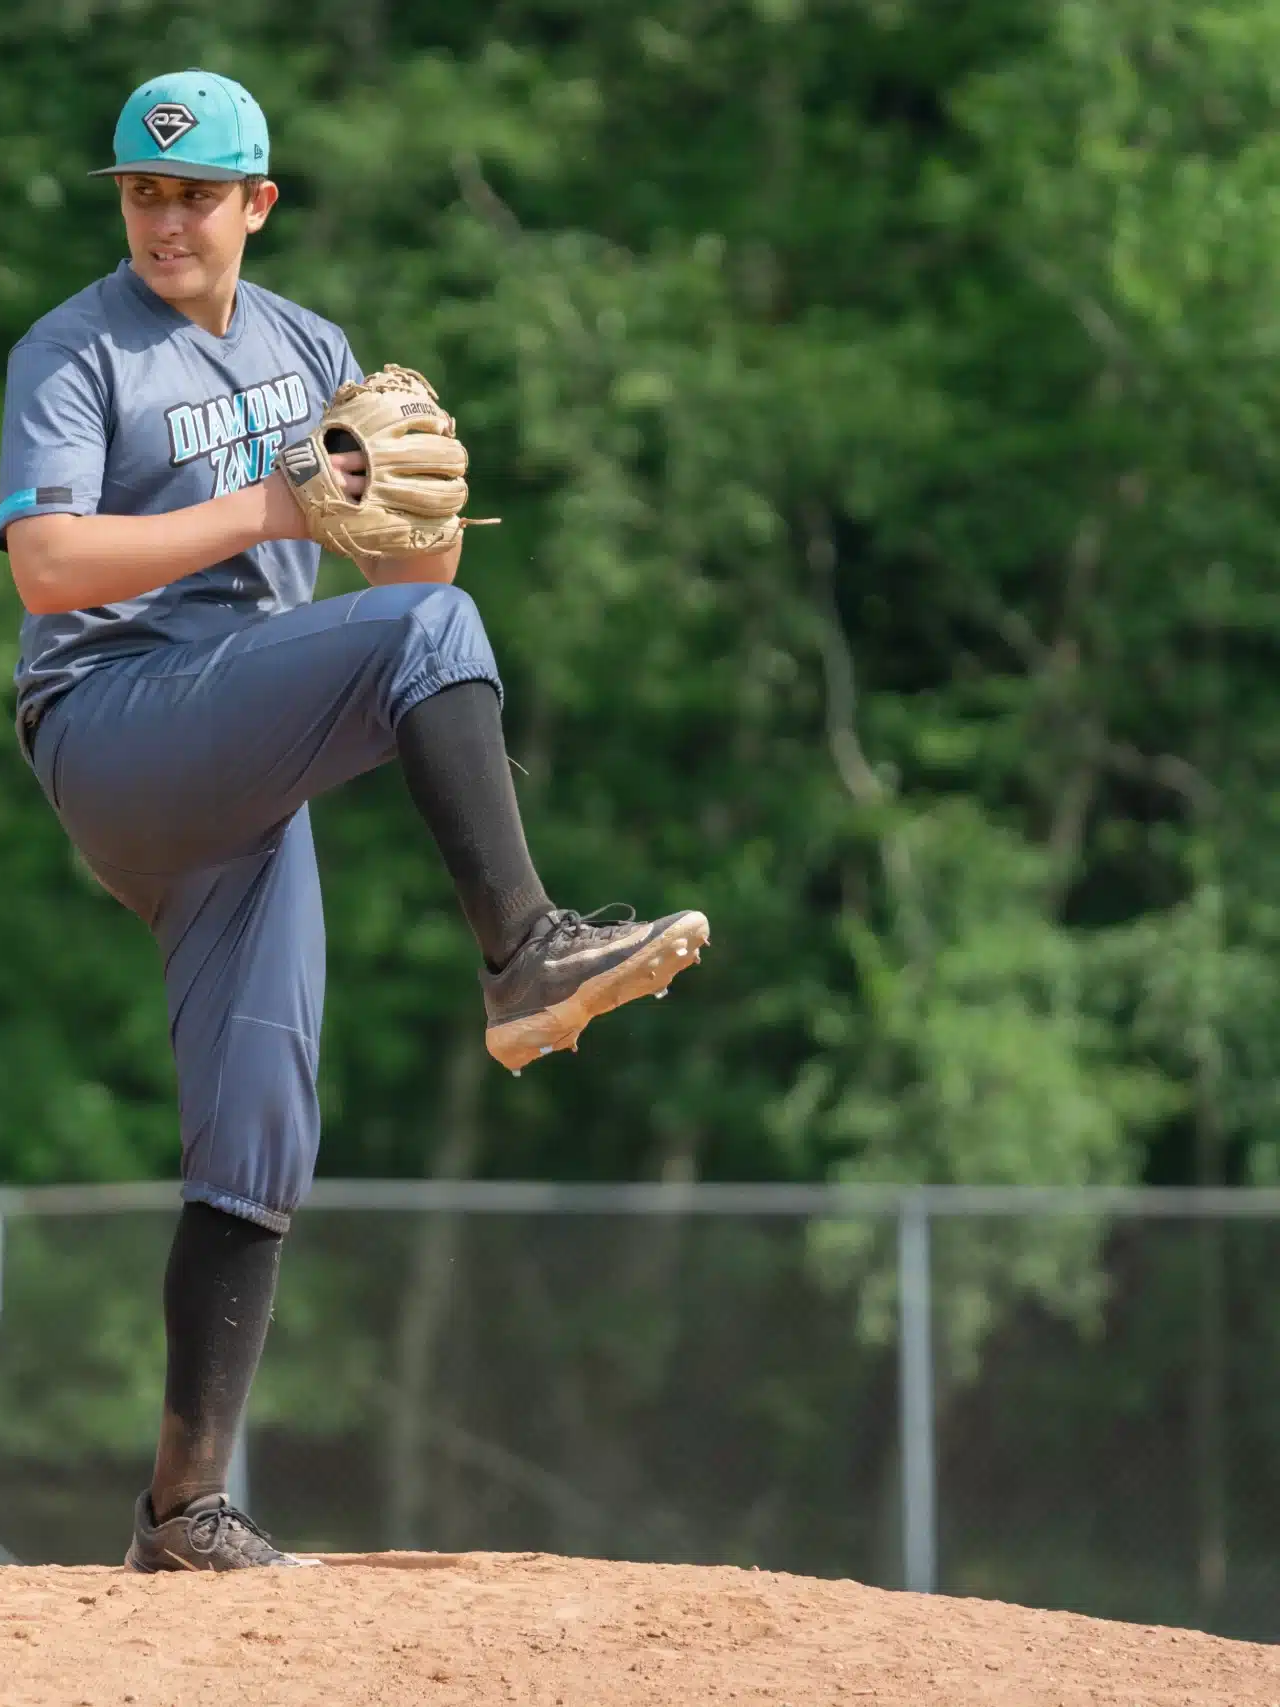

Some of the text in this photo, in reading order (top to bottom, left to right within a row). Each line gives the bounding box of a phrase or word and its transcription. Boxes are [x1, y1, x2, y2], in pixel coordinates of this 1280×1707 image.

[166, 373, 310, 465] DIAMOND
[399, 401, 438, 417] marucc
[209, 429, 283, 500] ZONE
